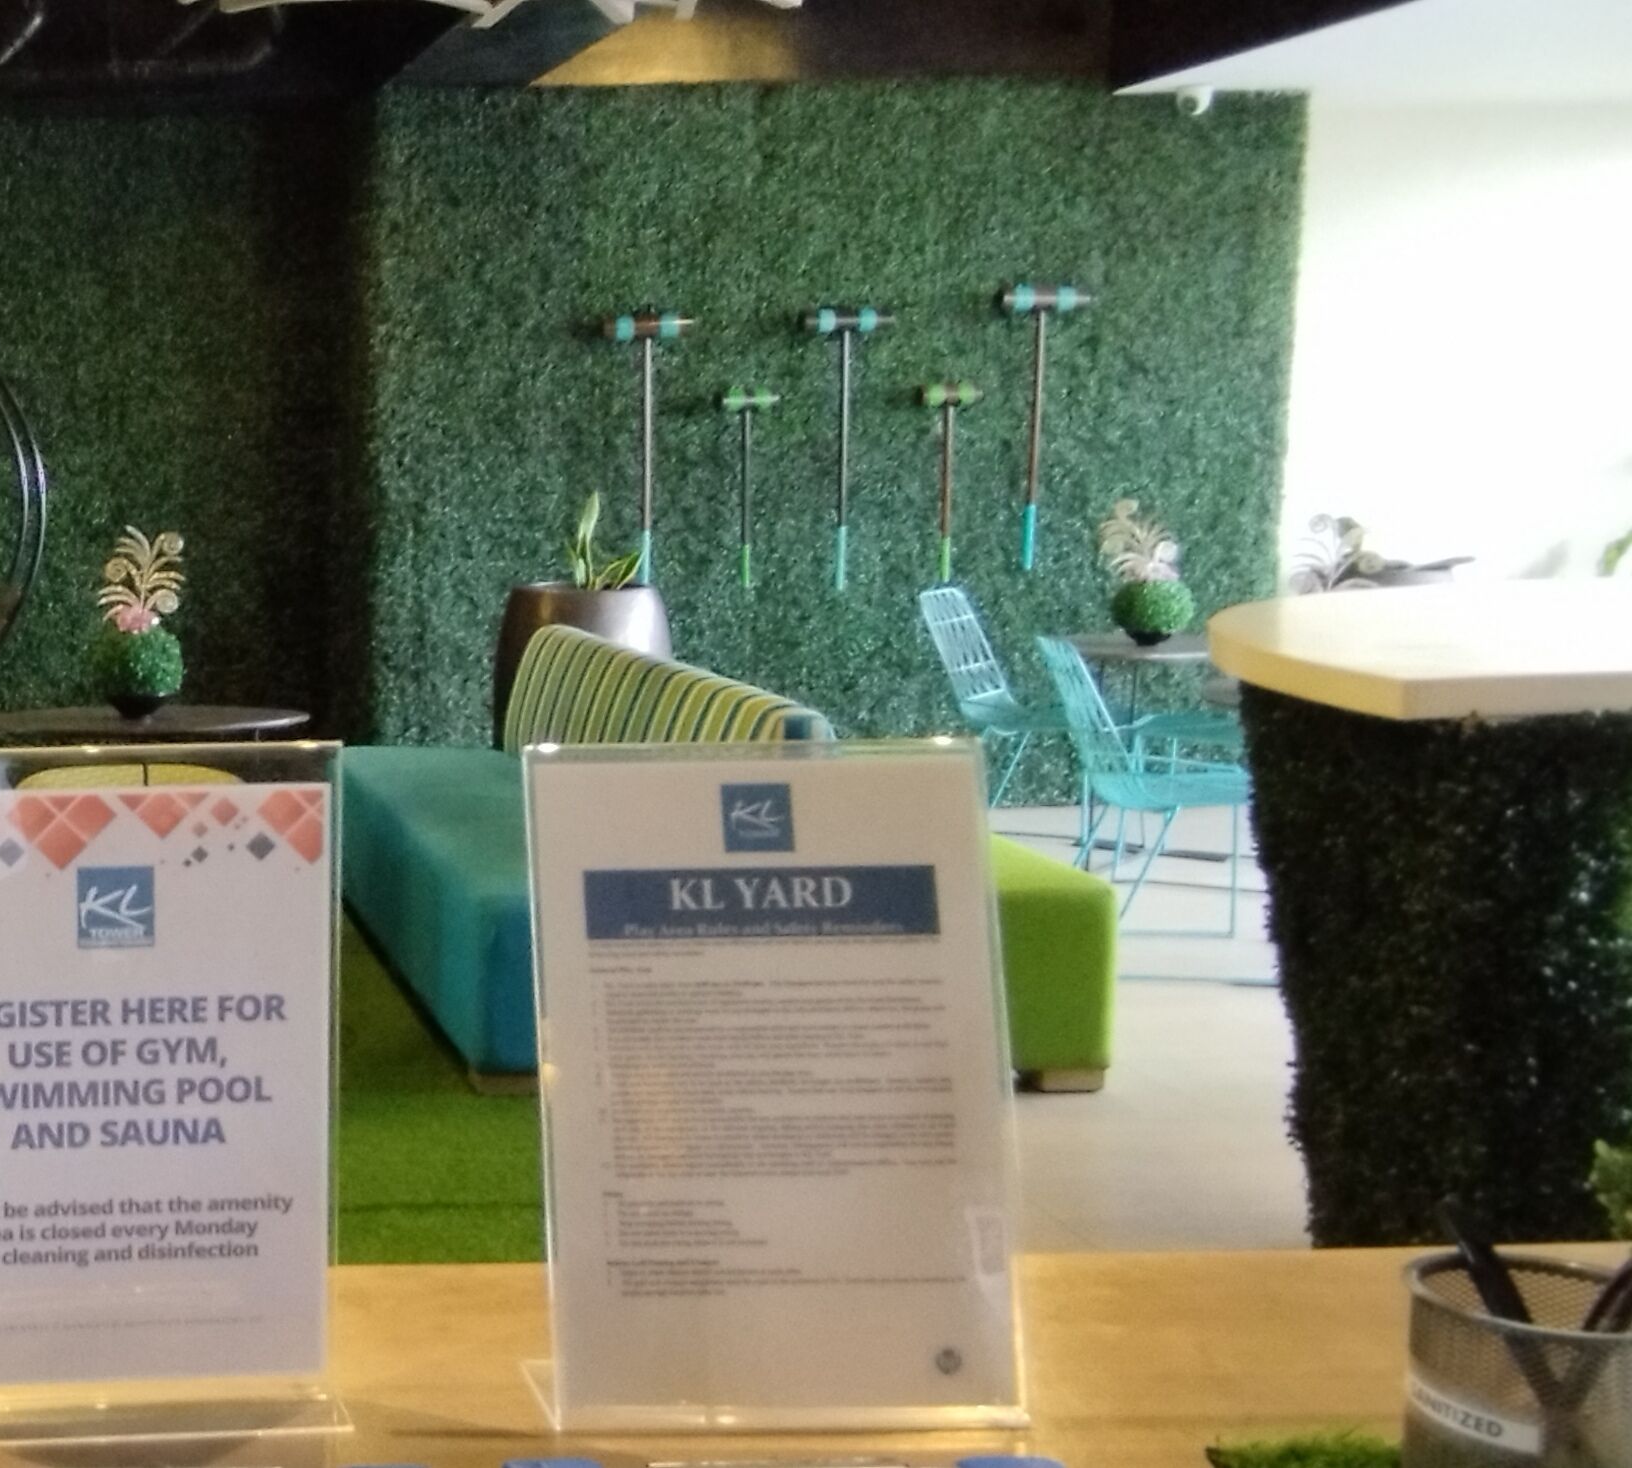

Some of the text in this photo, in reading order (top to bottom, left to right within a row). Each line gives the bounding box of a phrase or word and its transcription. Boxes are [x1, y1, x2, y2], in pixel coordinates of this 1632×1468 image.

[730, 799, 786, 830] KL
[79, 884, 153, 930] KL
[669, 875, 853, 910] KL YARD
[120, 996, 209, 1026] HERE
[217, 994, 288, 1023] FOR
[7, 1035, 229, 1069] USE OF GYM,
[175, 1075, 273, 1105] POOL
[10, 1117, 227, 1150] AND SAUNA
[3, 1201, 29, 1218] be
[33, 1199, 114, 1217] advised
[118, 1197, 163, 1214] that
[168, 1195, 202, 1213] the
[206, 1193, 294, 1215] amenity
[19, 1224, 36, 1241] is
[40, 1221, 107, 1241] closed
[110, 1222, 169, 1241] every
[174, 1216, 259, 1239] Monday
[1, 1245, 90, 1268] cleaning
[93, 1244, 133, 1262] and
[137, 1240, 259, 1261] disinfection
